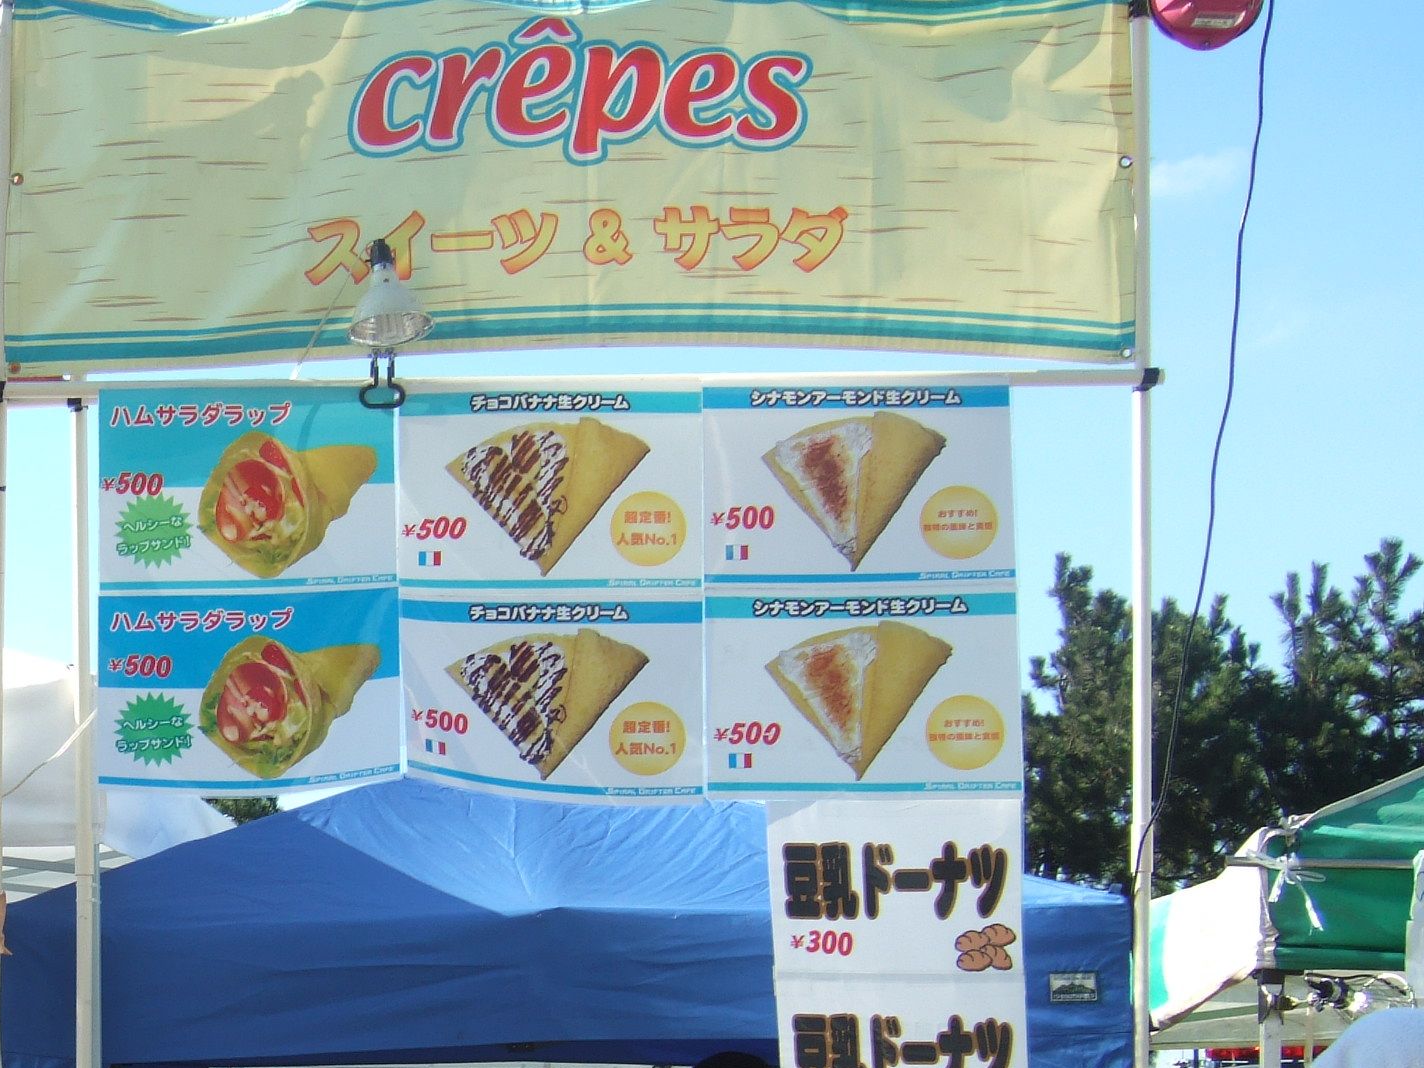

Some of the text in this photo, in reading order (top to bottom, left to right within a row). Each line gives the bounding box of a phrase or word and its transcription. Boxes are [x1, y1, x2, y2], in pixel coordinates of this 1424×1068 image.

[349, 15, 812, 164] crêpes
[304, 205, 849, 285] スイーツ & サラダ
[470, 393, 629, 411] チョコバナナ生クリーム
[750, 388, 961, 407] シナモンアーモンド生クリーム
[110, 401, 292, 428] ハムサラダラップ
[101, 472, 164, 496] ¥500
[402, 515, 467, 541] ¥500
[710, 505, 775, 530] ¥500
[110, 606, 294, 633] ハムサラダラップ
[469, 603, 629, 621] チョコバナナ生クリーム
[753, 597, 968, 617] シナモンアーモンド生クリーム
[108, 653, 172, 679] ¥500
[411, 708, 469, 735] ¥500
[714, 720, 782, 746] ¥500
[782, 840, 1008, 921] 豆乳ドーナツ
[790, 929, 854, 957] ¥300
